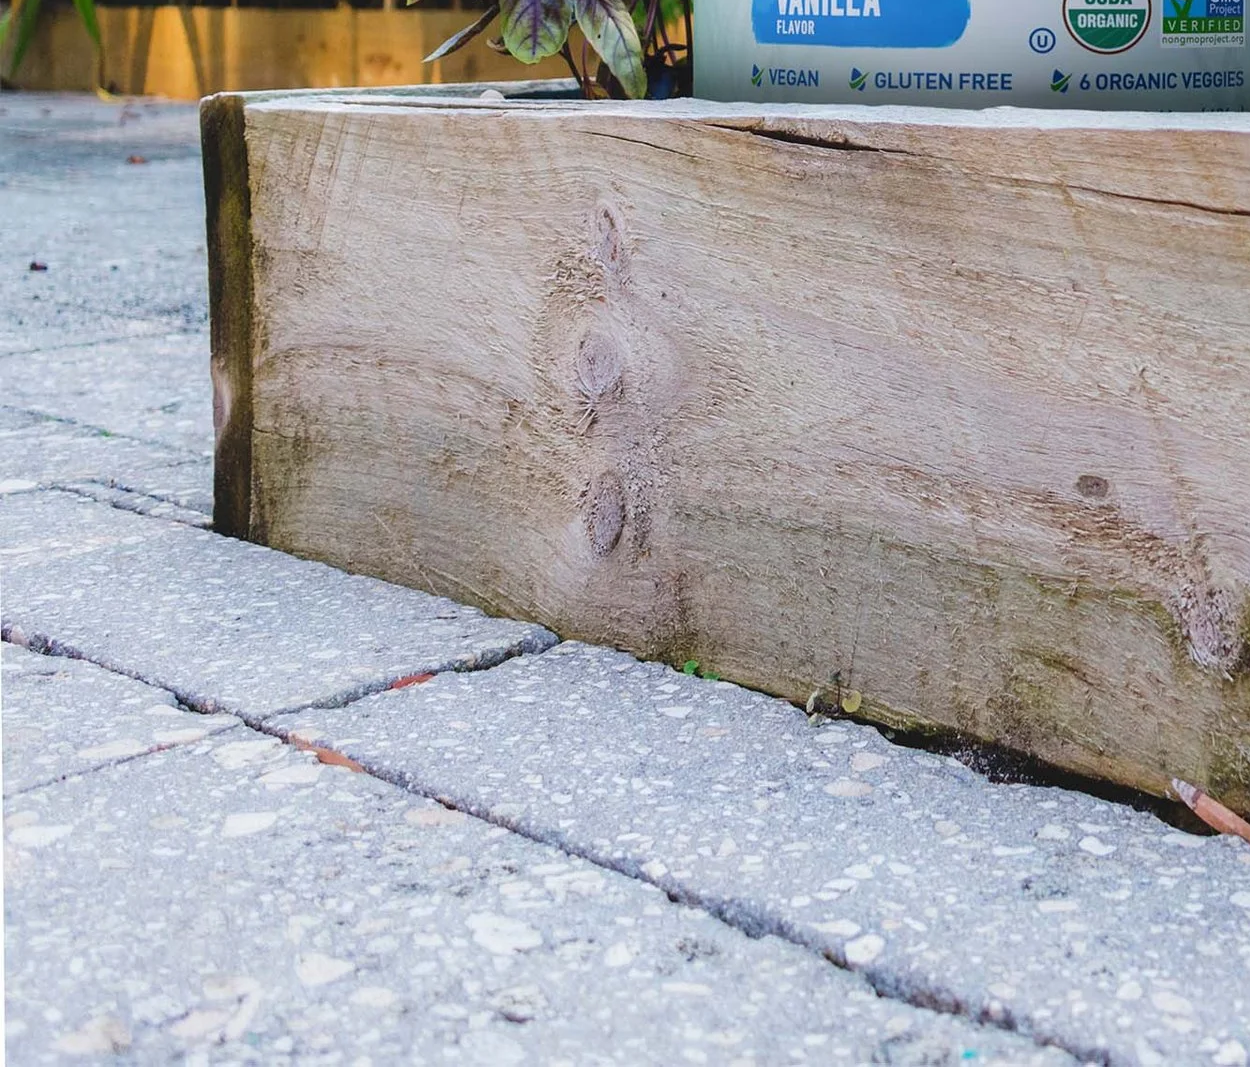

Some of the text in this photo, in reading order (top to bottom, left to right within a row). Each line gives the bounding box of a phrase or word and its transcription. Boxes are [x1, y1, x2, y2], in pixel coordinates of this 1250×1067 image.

[1209, 4, 1241, 17] Project
[777, 20, 815, 35] FLAVOR
[1077, 13, 1138, 29] ORGANIC
[1168, 20, 1241, 32] VERIFIED
[1162, 35, 1244, 46] nongmoproject.org
[769, 68, 819, 88] VEGAN
[875, 71, 1012, 91] GLUTEN FREE
[1079, 71, 1244, 90] 6 ORGANIC VEGGIES
